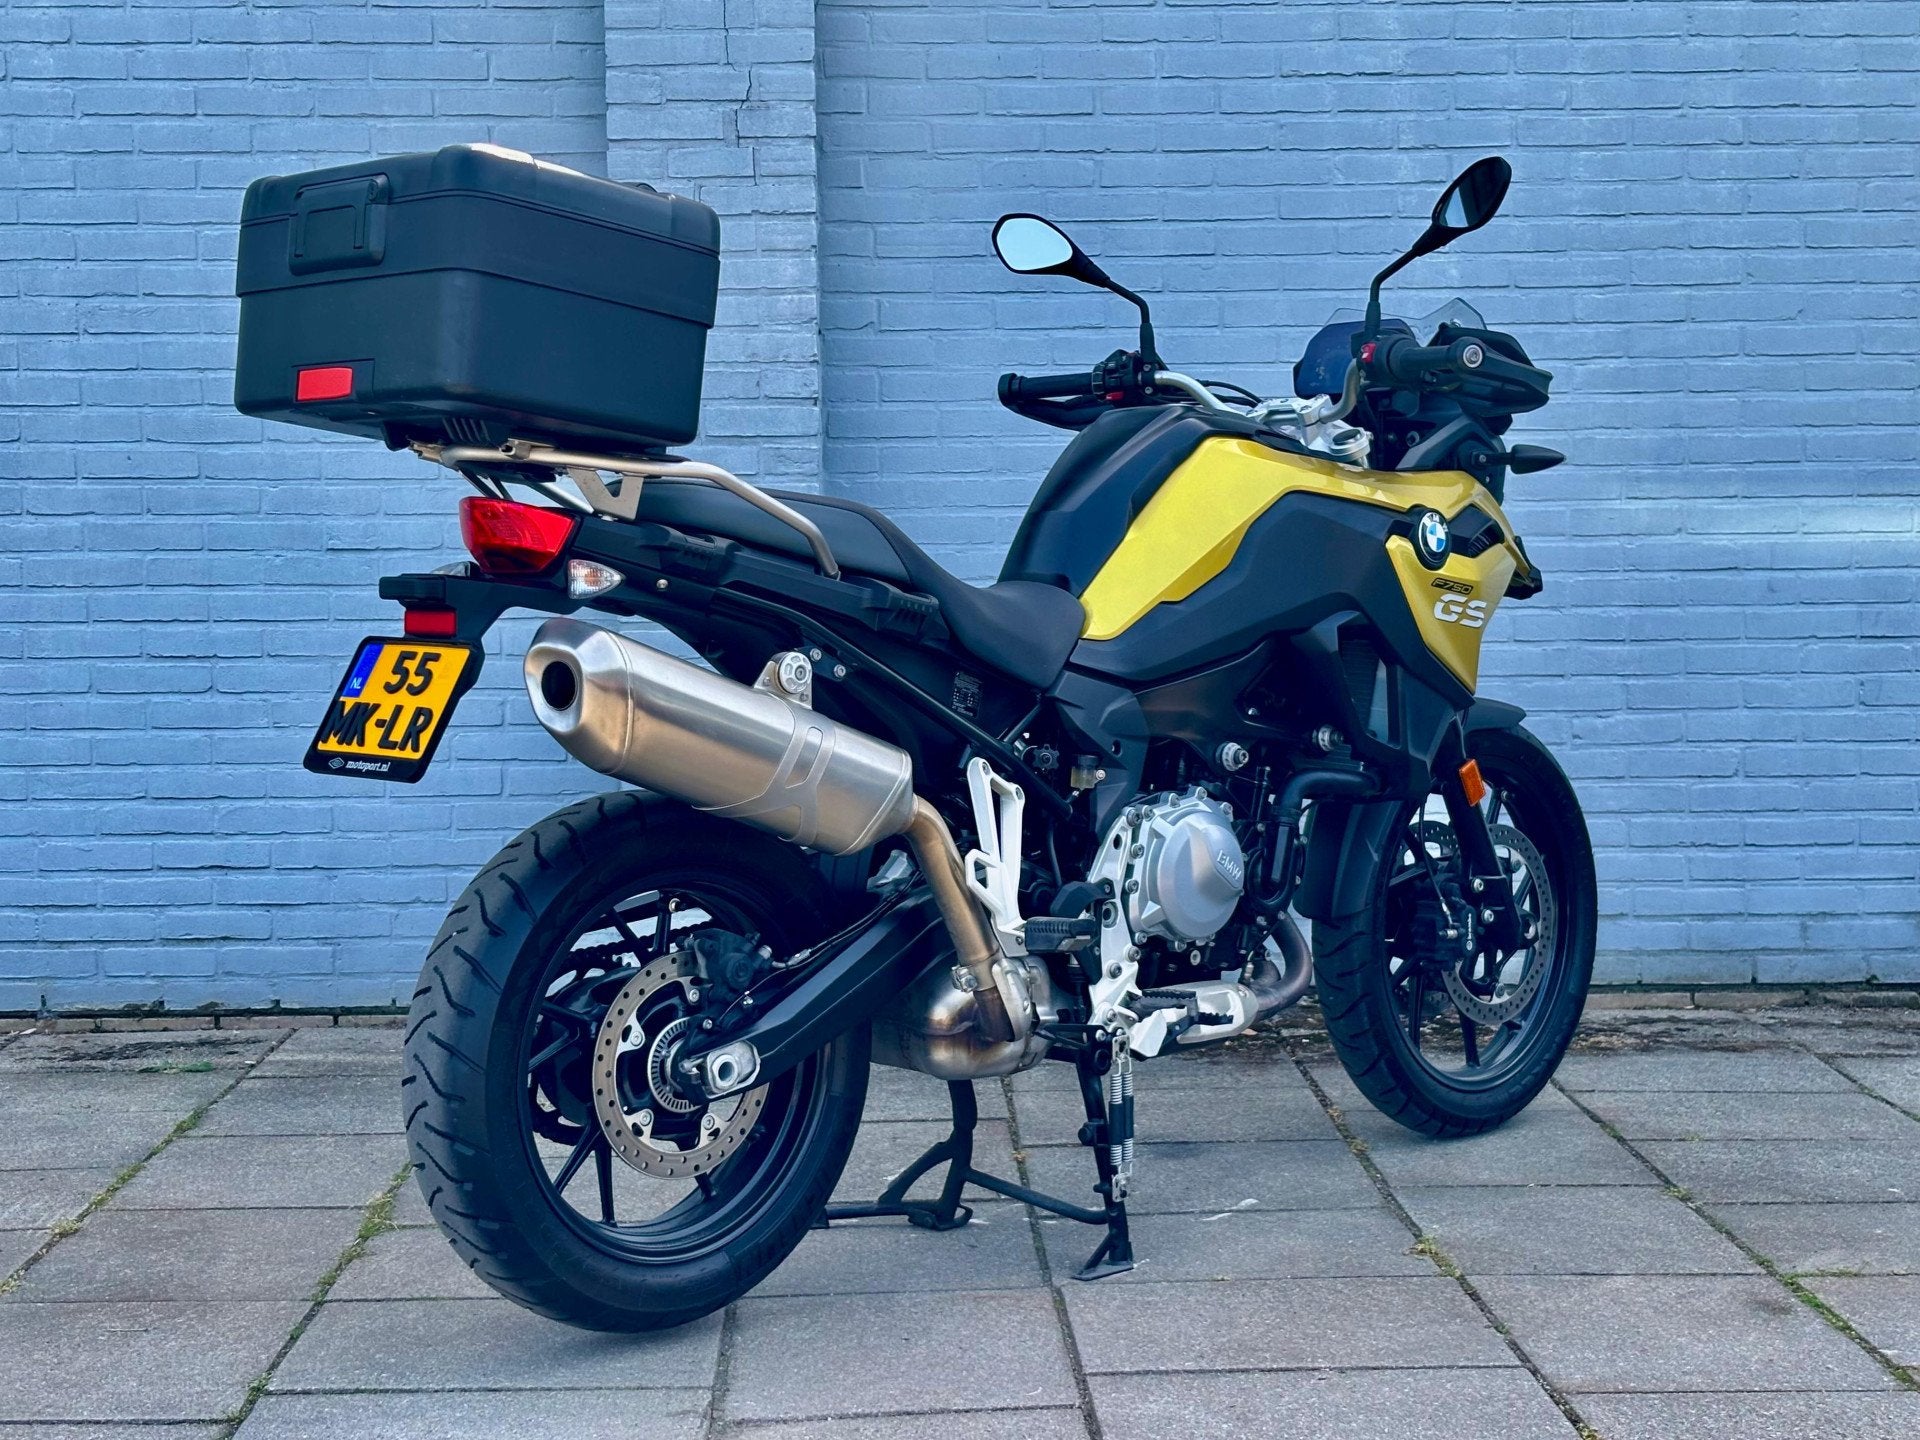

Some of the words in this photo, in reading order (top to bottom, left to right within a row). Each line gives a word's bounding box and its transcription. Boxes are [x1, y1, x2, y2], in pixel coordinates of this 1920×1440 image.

[1432, 579, 1473, 594] F750
[1433, 593, 1487, 628] GS
[350, 677, 362, 689] NL
[383, 650, 442, 696] 55
[319, 700, 434, 753] MK-LR
[345, 760, 391, 772] motoport.nl
[1216, 849, 1242, 880] BMW
